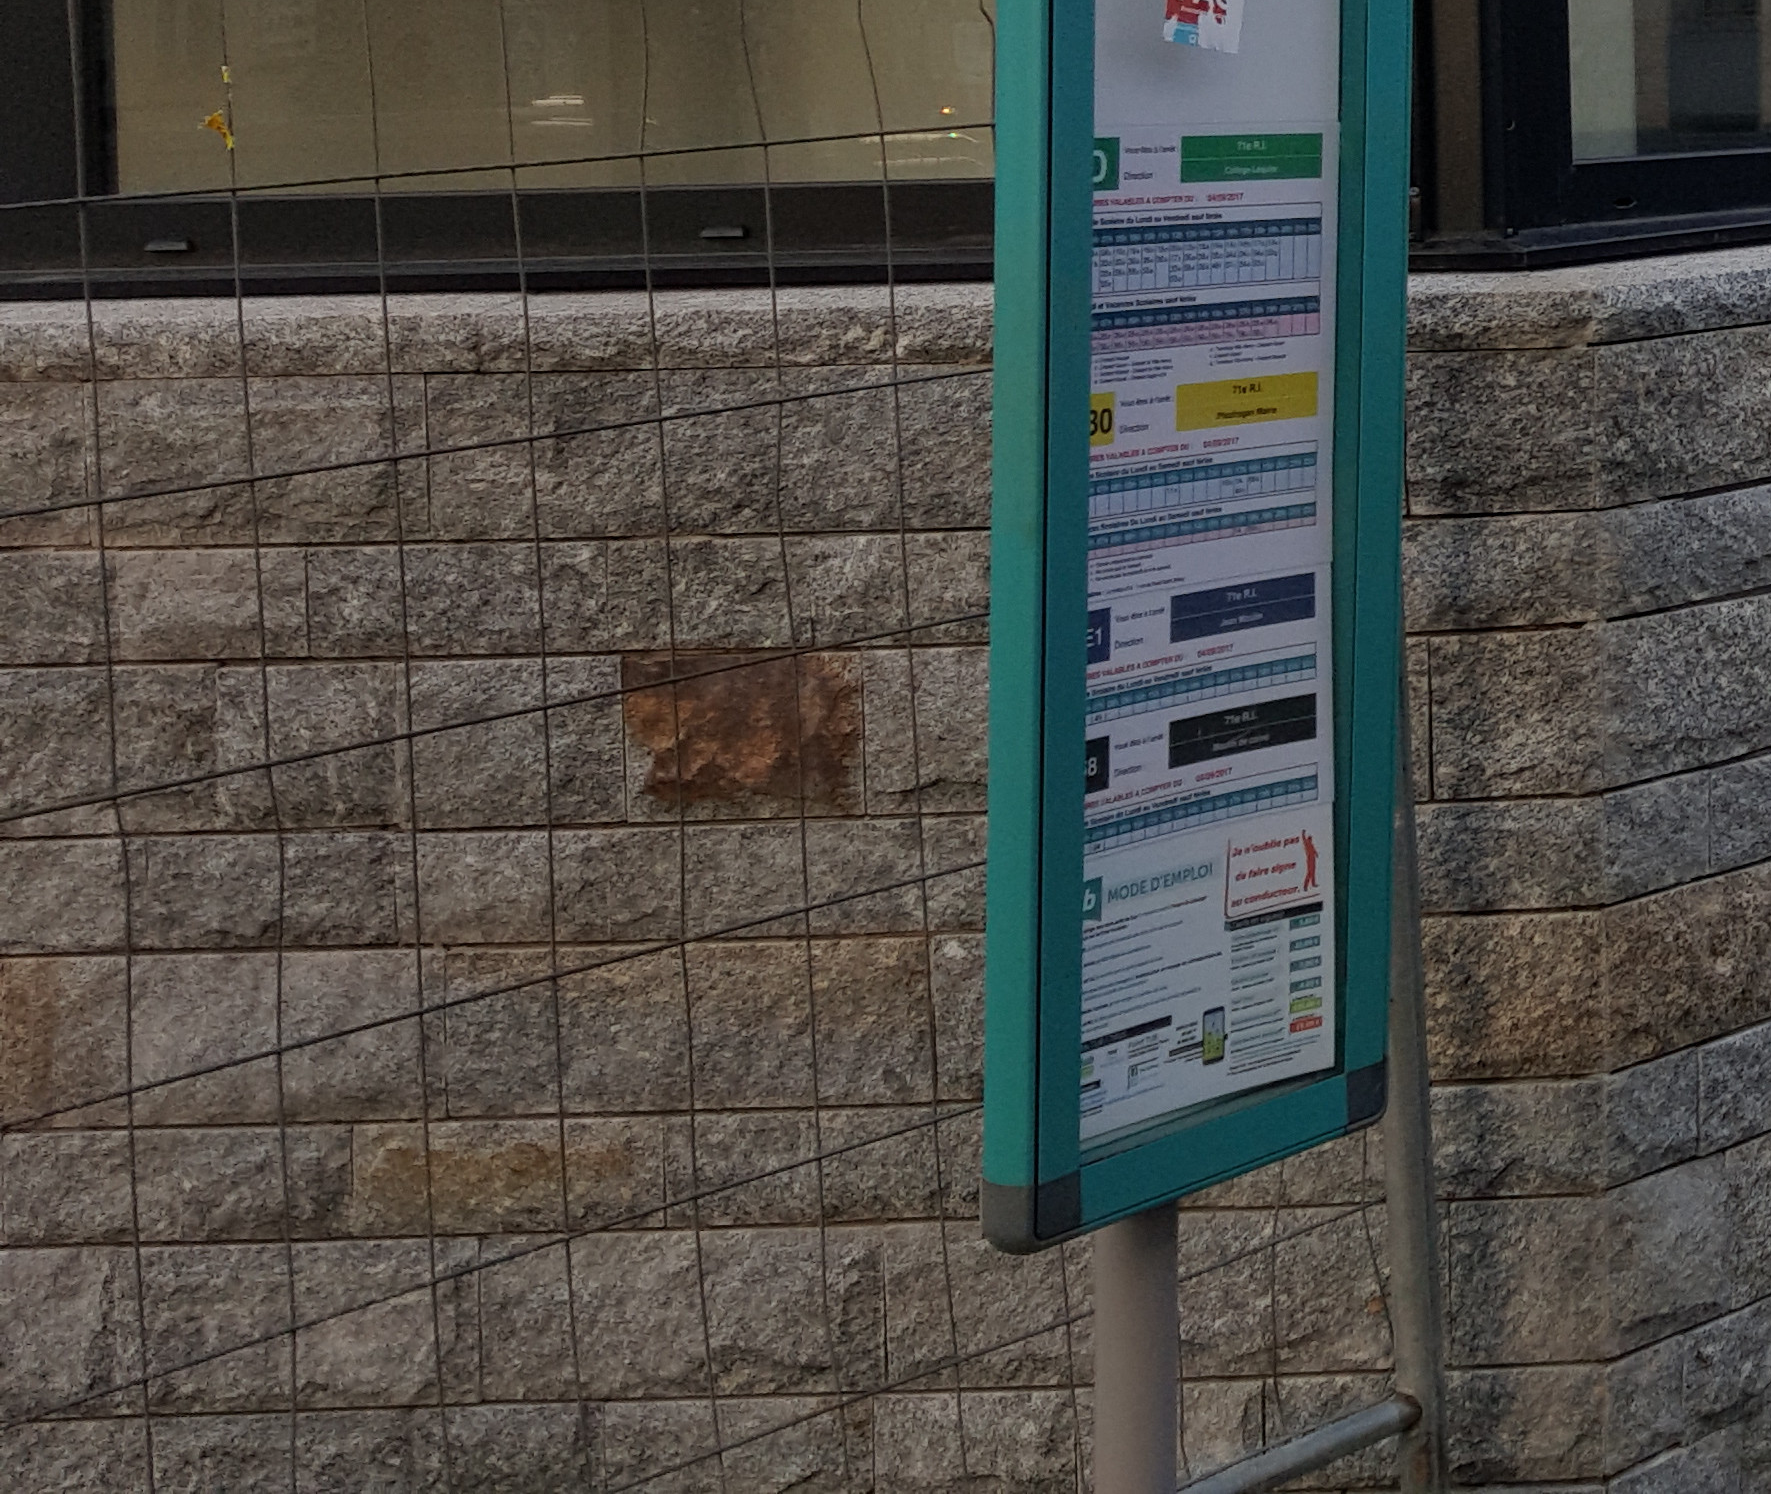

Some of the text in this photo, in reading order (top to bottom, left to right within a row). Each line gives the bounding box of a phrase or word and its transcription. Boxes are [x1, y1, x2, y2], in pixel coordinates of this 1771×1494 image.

[1124, 172, 1153, 181] Direction
[1232, 385, 1247, 394] 71e
[1119, 423, 1149, 434] Direction
[1114, 637, 1144, 650] Direction
[1114, 765, 1142, 778] Direction
[1231, 835, 1300, 857] Je n'oublie pas
[1248, 866, 1270, 880] faire
[1271, 861, 1297, 877] signe
[1107, 862, 1214, 904] MODE D'EMPLOI
